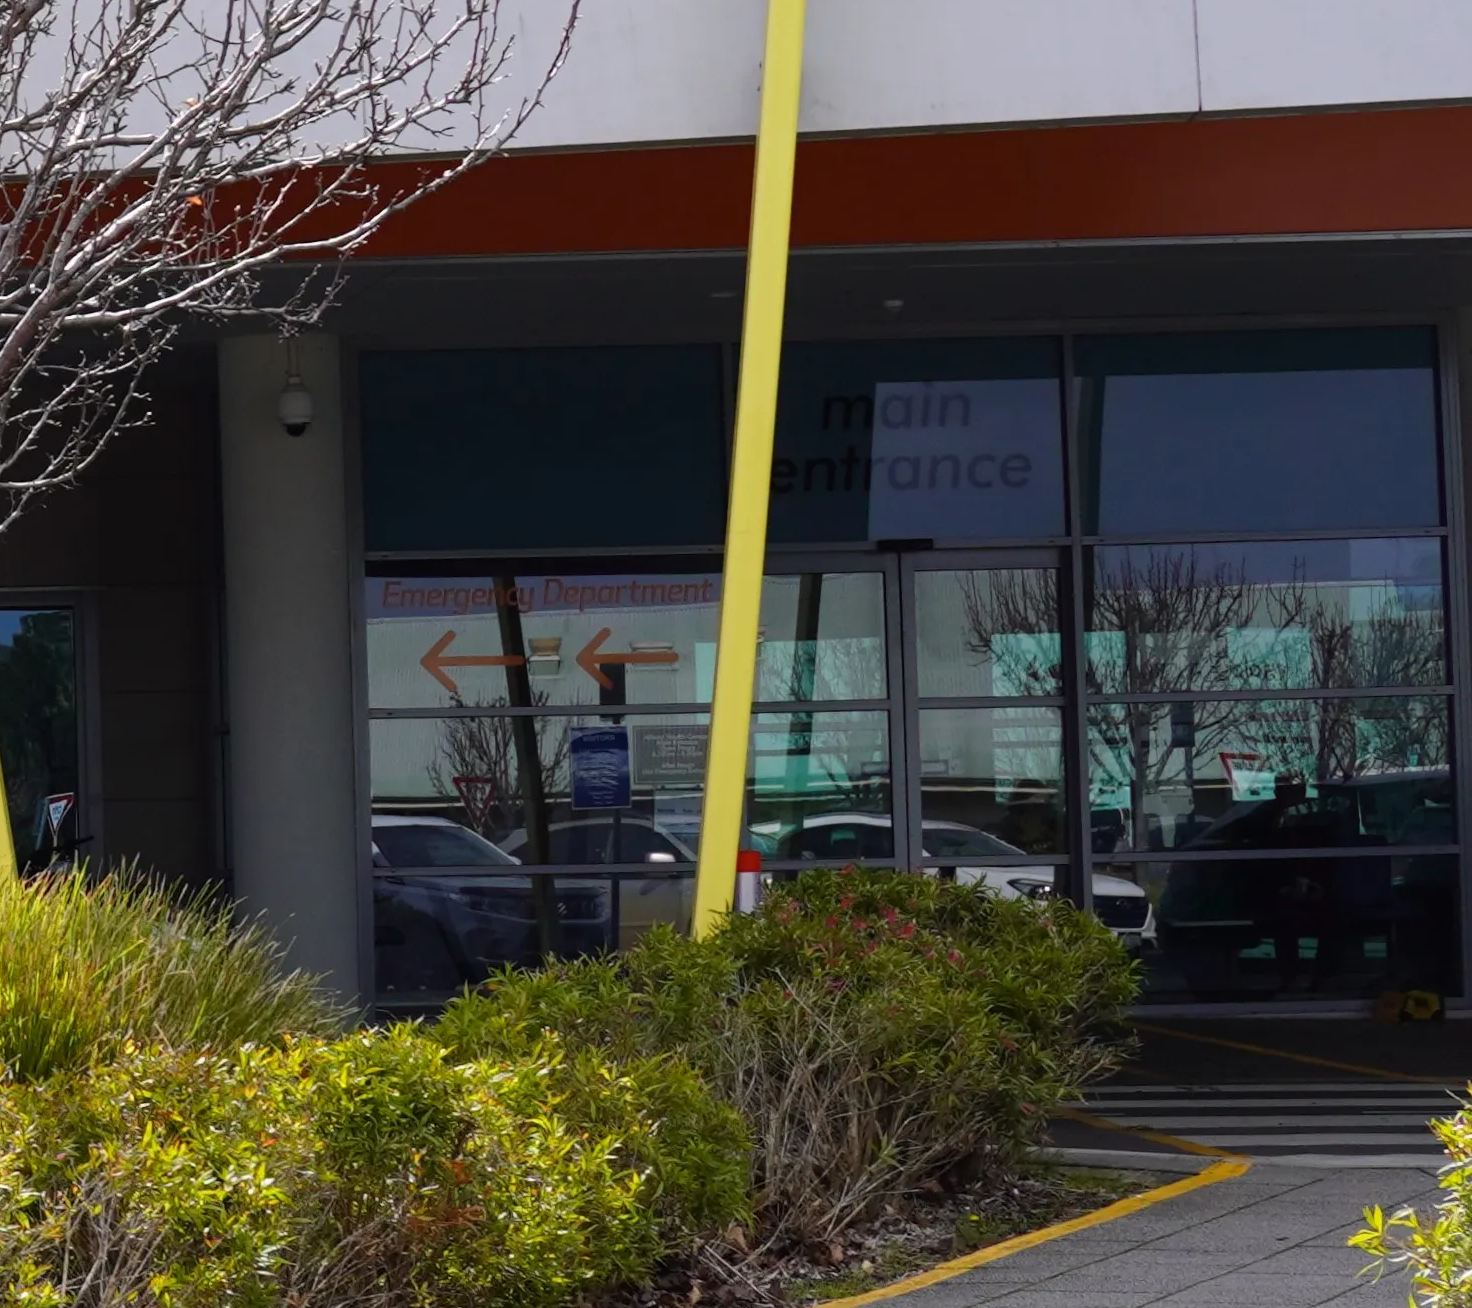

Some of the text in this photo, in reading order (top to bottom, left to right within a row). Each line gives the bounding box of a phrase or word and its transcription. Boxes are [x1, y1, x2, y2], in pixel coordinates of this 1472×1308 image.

[822, 380, 972, 430] main
[770, 445, 1032, 494] entrance
[382, 578, 712, 615] Emergency Department
